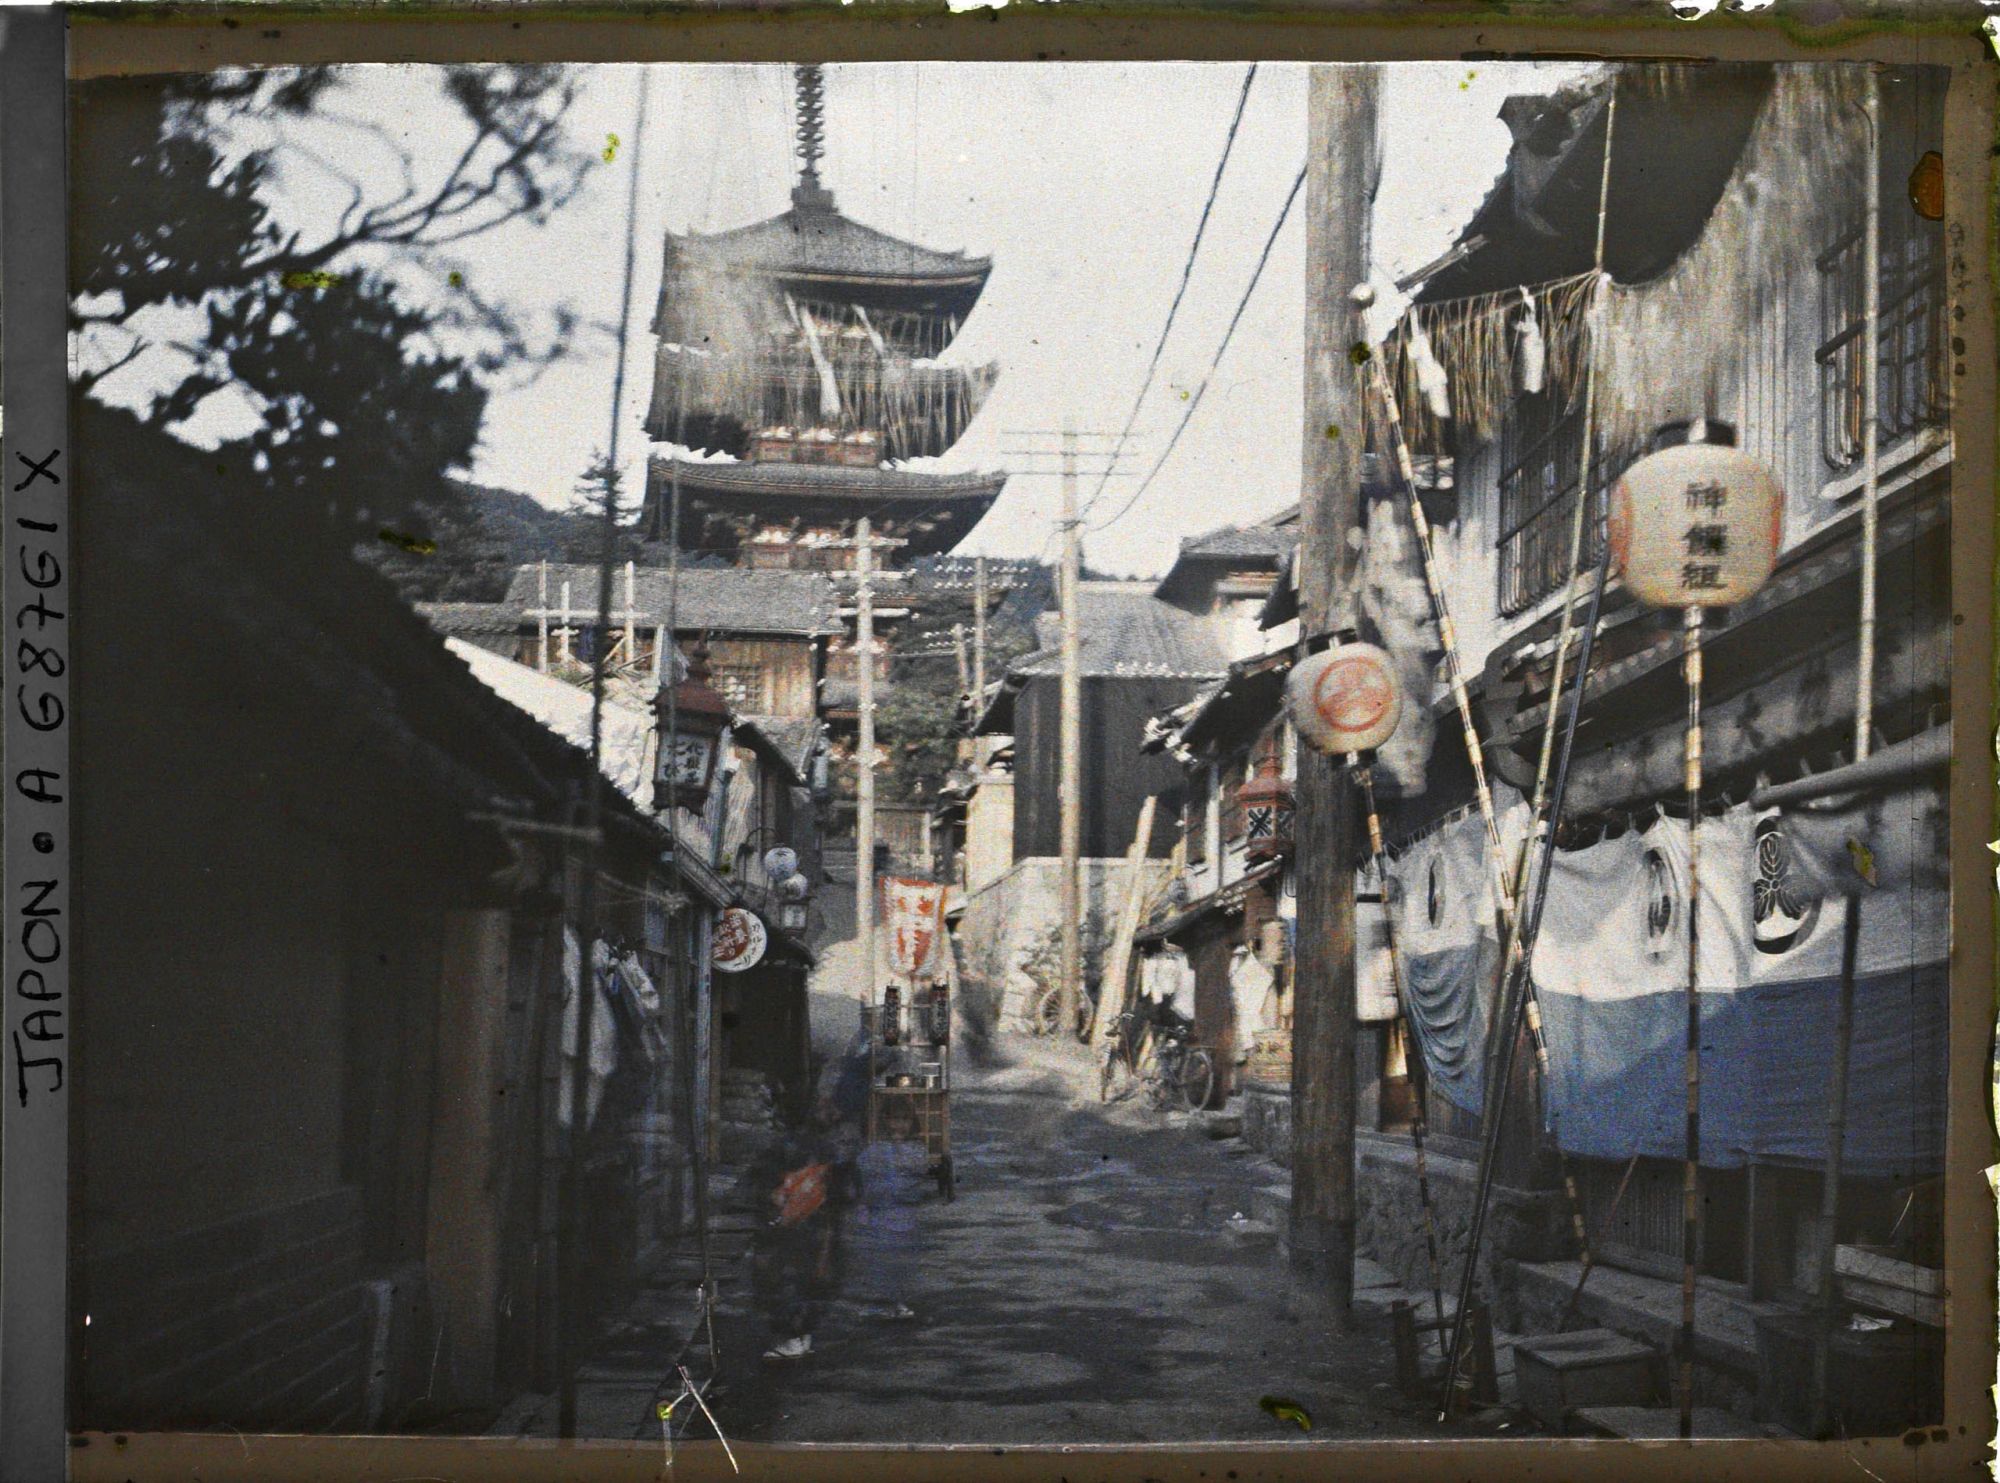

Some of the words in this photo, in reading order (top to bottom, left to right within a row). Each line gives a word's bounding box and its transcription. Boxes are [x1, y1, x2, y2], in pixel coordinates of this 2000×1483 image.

[13, 448, 62, 493] X
[15, 767, 65, 805] A
[13, 879, 66, 1109] JAPON
